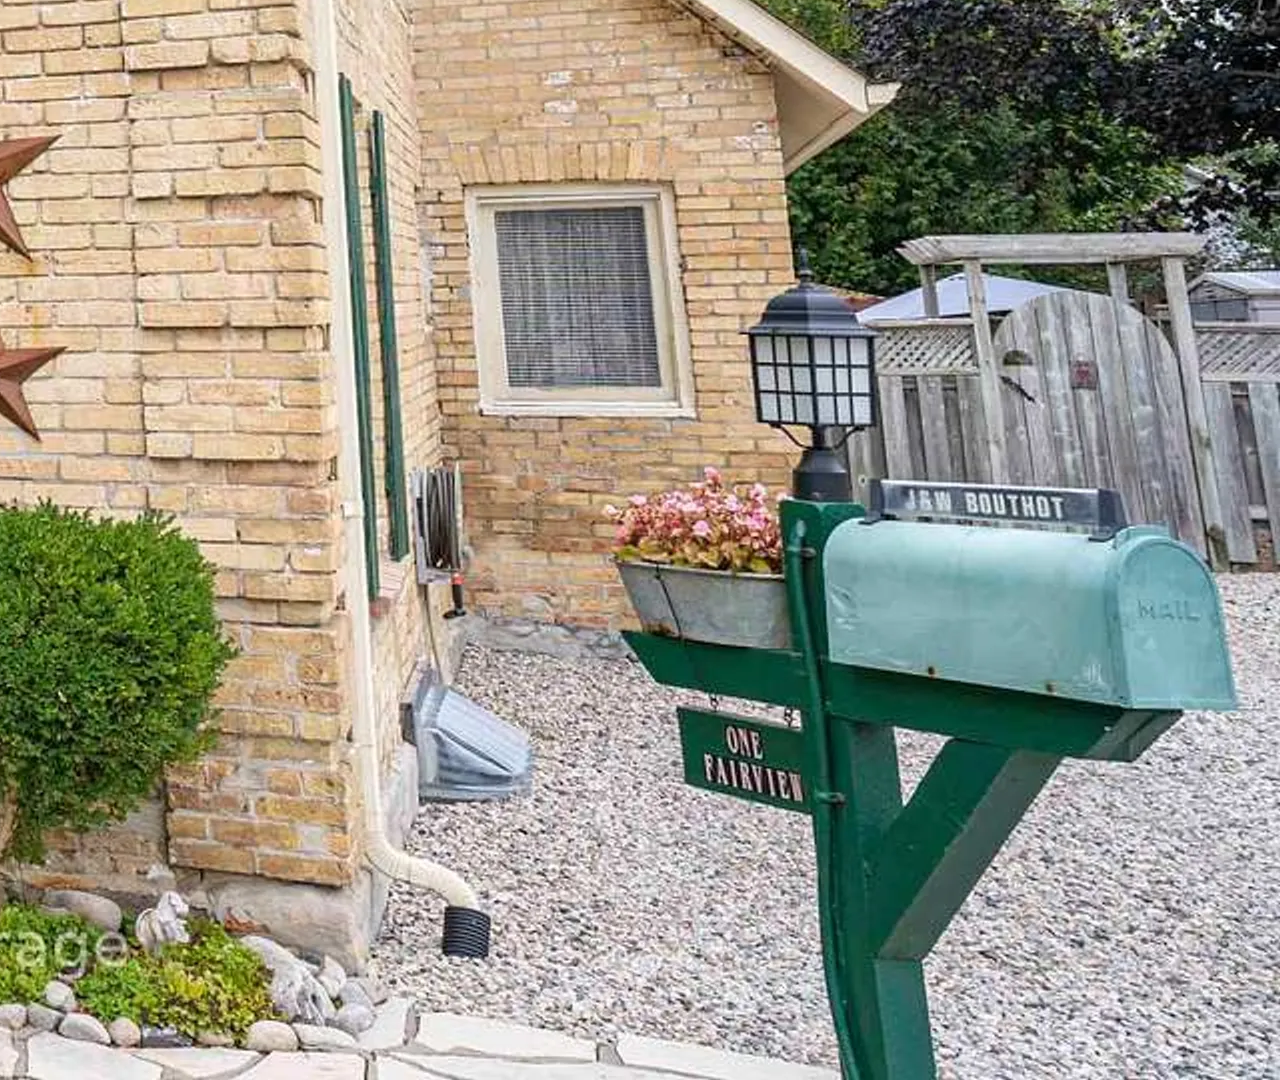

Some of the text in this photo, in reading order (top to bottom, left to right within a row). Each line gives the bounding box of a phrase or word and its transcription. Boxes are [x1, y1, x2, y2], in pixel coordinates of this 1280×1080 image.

[964, 491, 1064, 519] BOUTHOT
[1137, 599, 1200, 621] MAIL
[726, 725, 763, 759] ONE
[704, 753, 803, 802] FAIRVIEW
